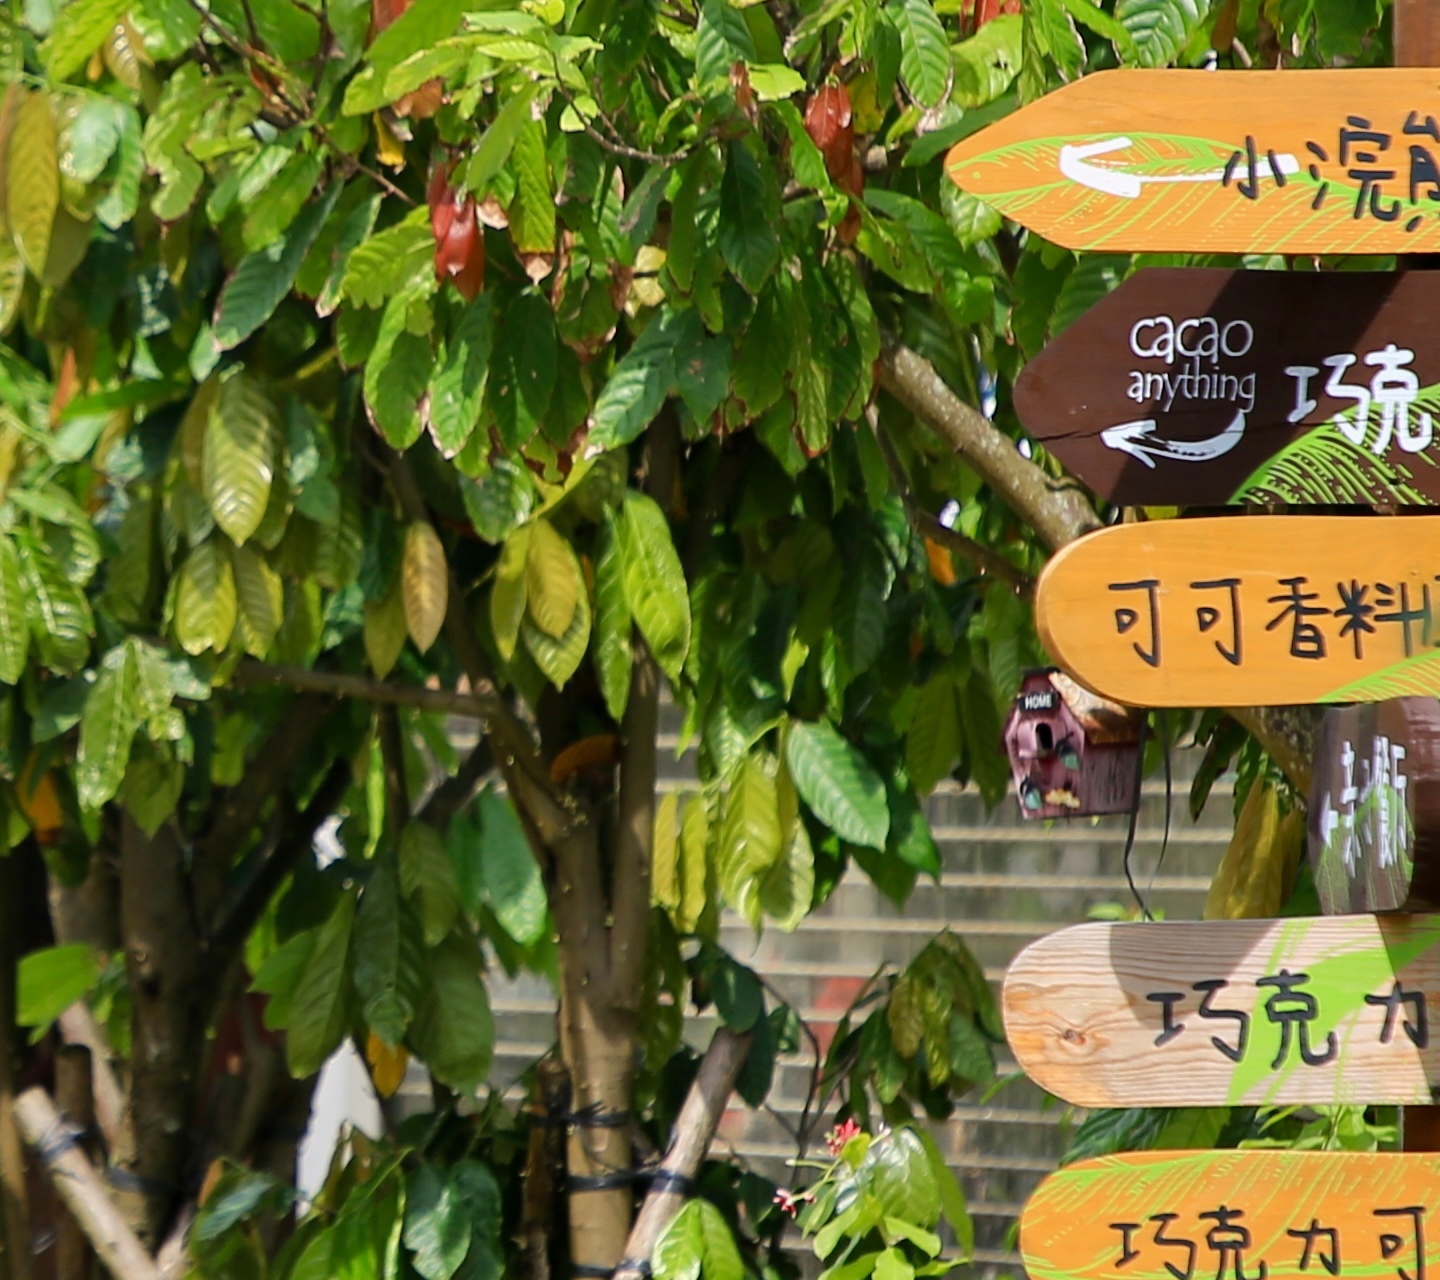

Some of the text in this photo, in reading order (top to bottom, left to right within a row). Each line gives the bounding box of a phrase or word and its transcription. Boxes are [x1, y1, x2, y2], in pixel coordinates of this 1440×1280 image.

[1129, 315, 1254, 364] cacao
[1126, 357, 1256, 412] anything
[1024, 693, 1053, 710] HOME
